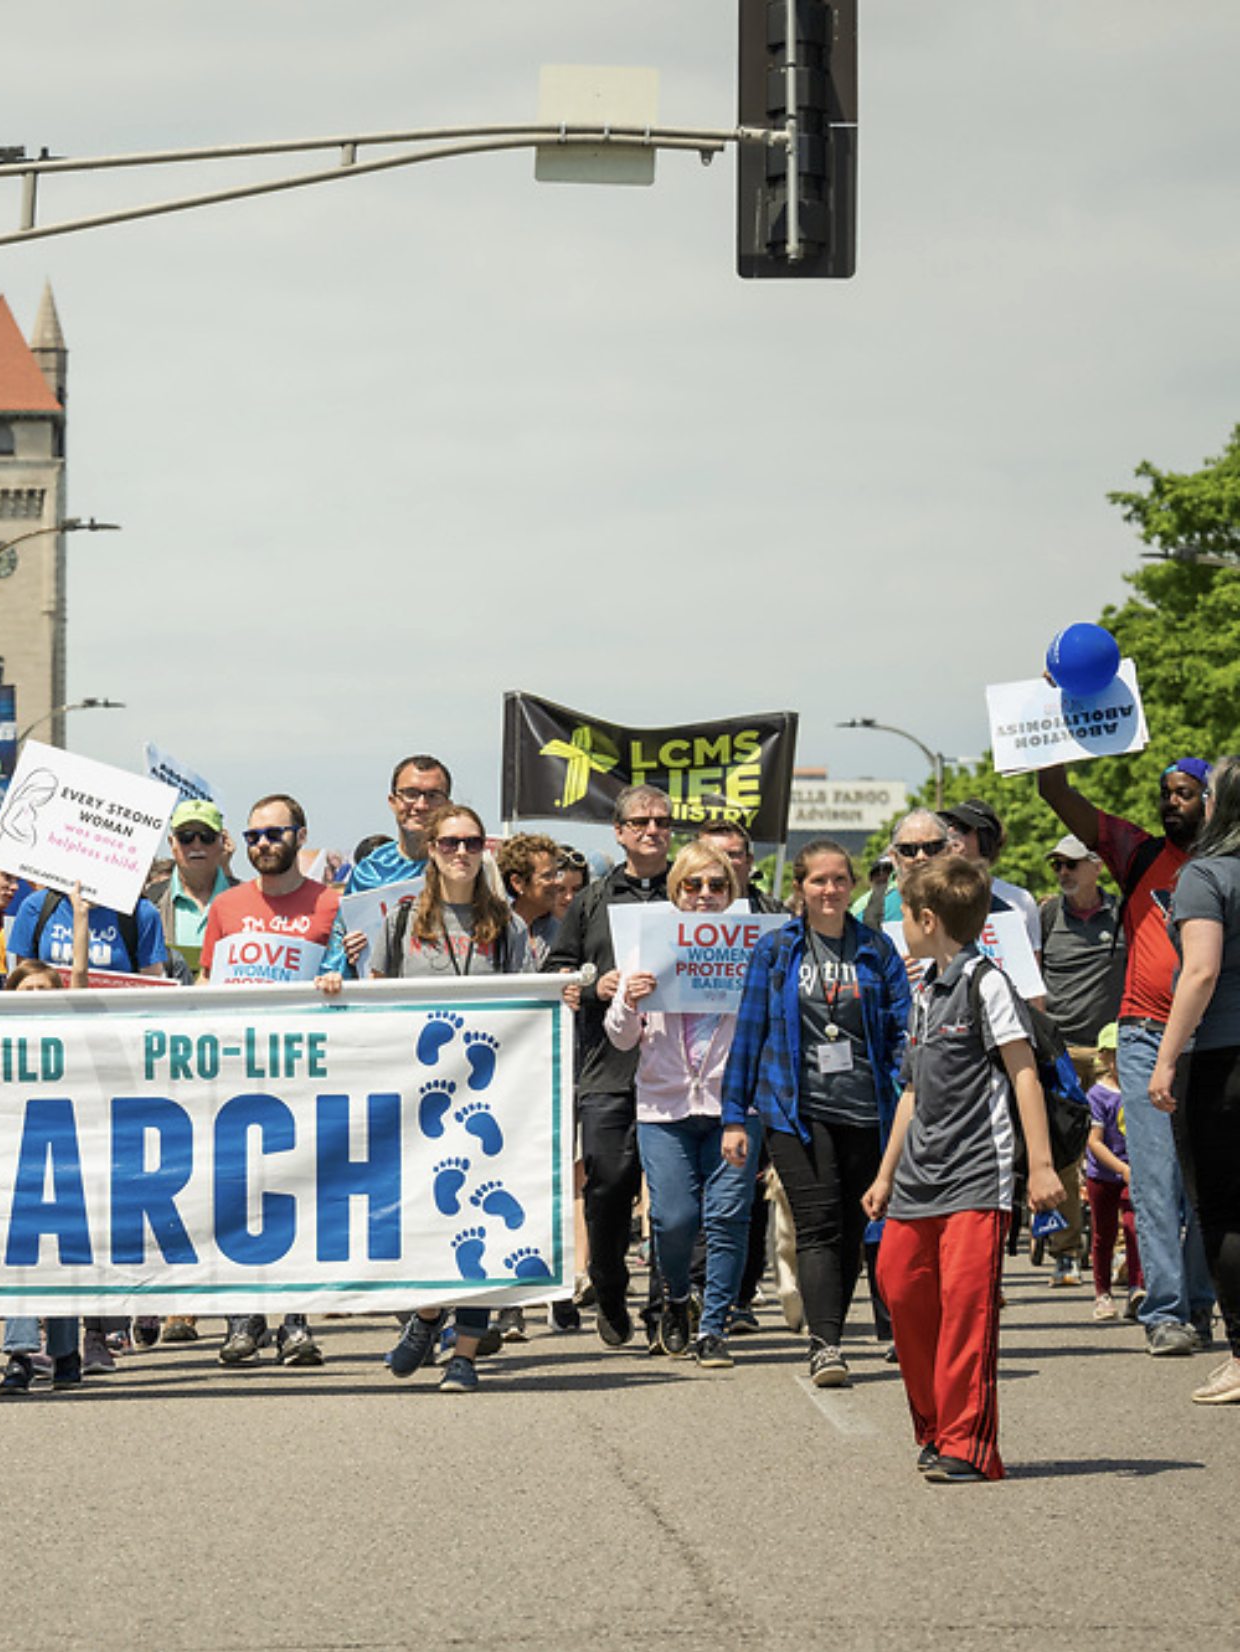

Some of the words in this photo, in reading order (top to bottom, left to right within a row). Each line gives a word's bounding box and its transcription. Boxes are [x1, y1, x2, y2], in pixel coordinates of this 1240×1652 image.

[631, 730, 761, 769] LCMS
[60, 787, 106, 810] EVERY
[106, 803, 162, 830] STRONG
[791, 789, 826, 805] ELLS
[833, 789, 890, 805] FARGO
[79, 810, 134, 837] WOMAN
[678, 923, 760, 947] LOVE
[227, 942, 302, 971] LOVE
[686, 947, 751, 962] WOMEN
[233, 964, 292, 982] WOMEN
[676, 962, 747, 977] PROTEC
[4, 1093, 402, 1266] ARCH
